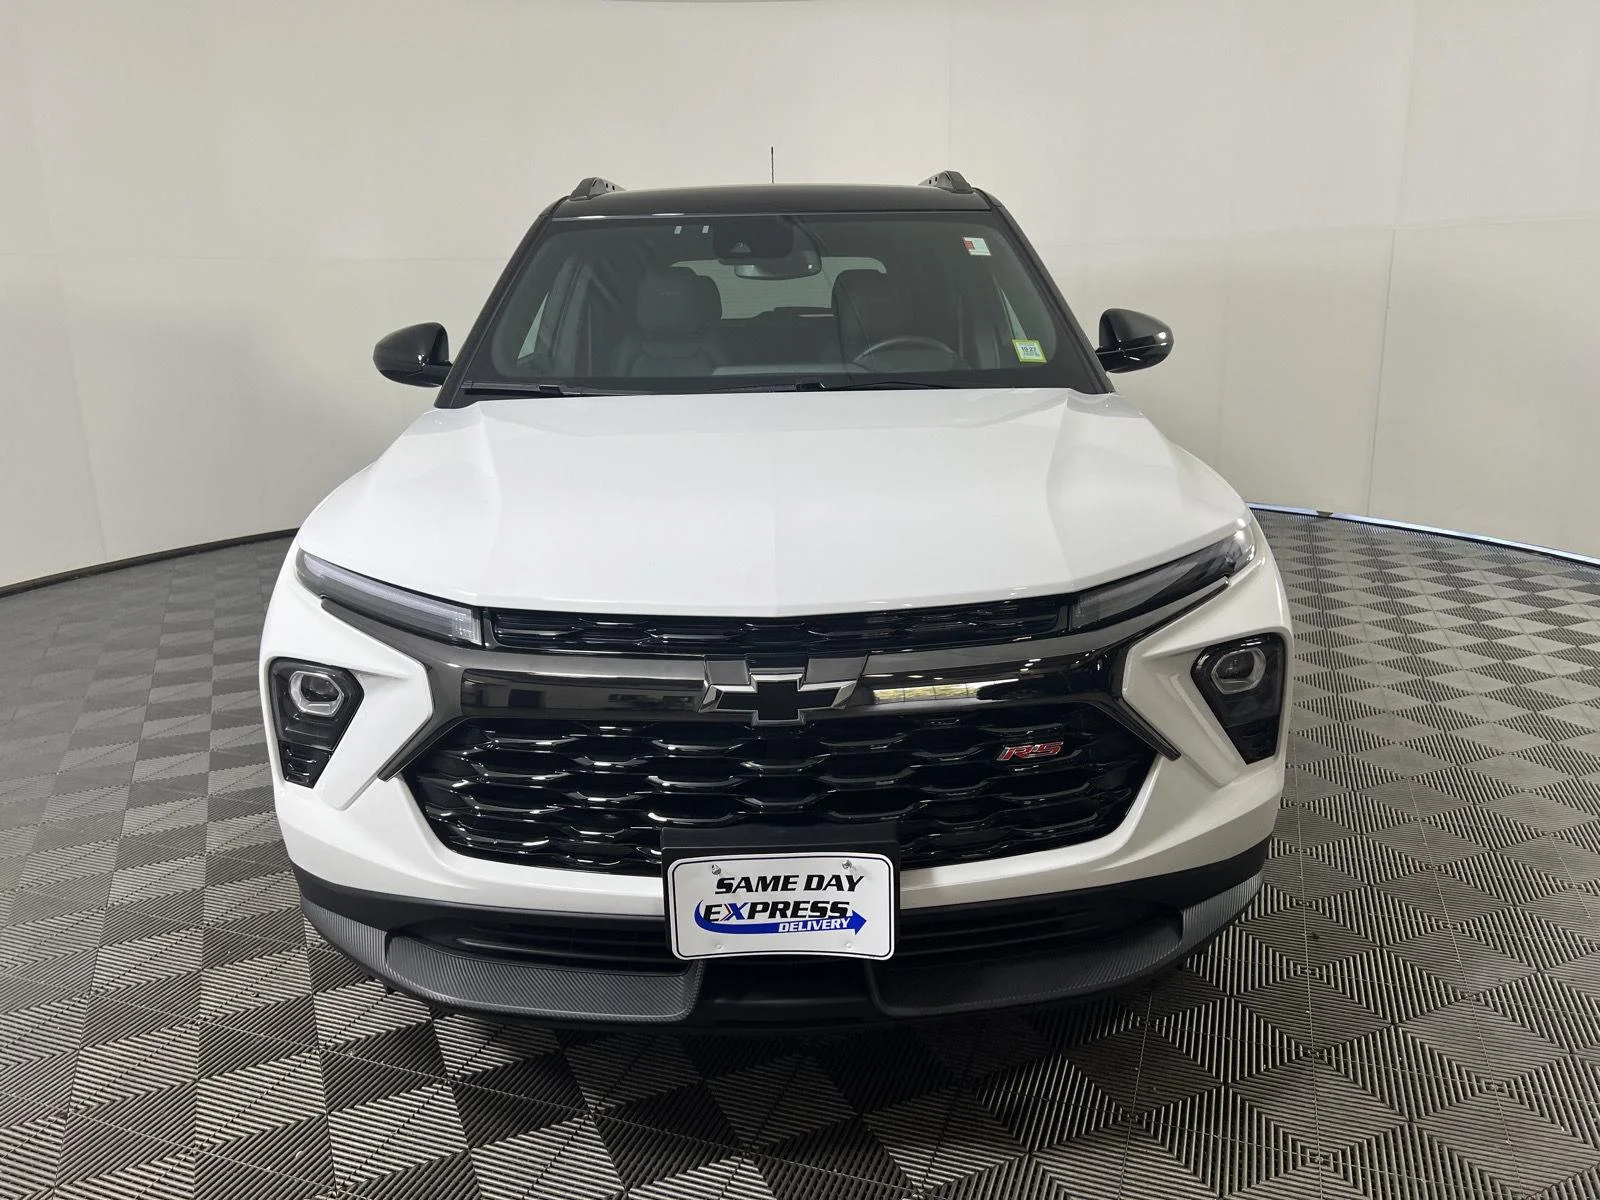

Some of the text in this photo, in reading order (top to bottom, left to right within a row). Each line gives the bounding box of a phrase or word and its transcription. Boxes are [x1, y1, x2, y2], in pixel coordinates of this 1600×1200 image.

[997, 741, 1063, 761] RS
[715, 874, 865, 895] SAME DAY
[703, 900, 850, 922] EXPRESS
[778, 916, 851, 933] DELIVERY
